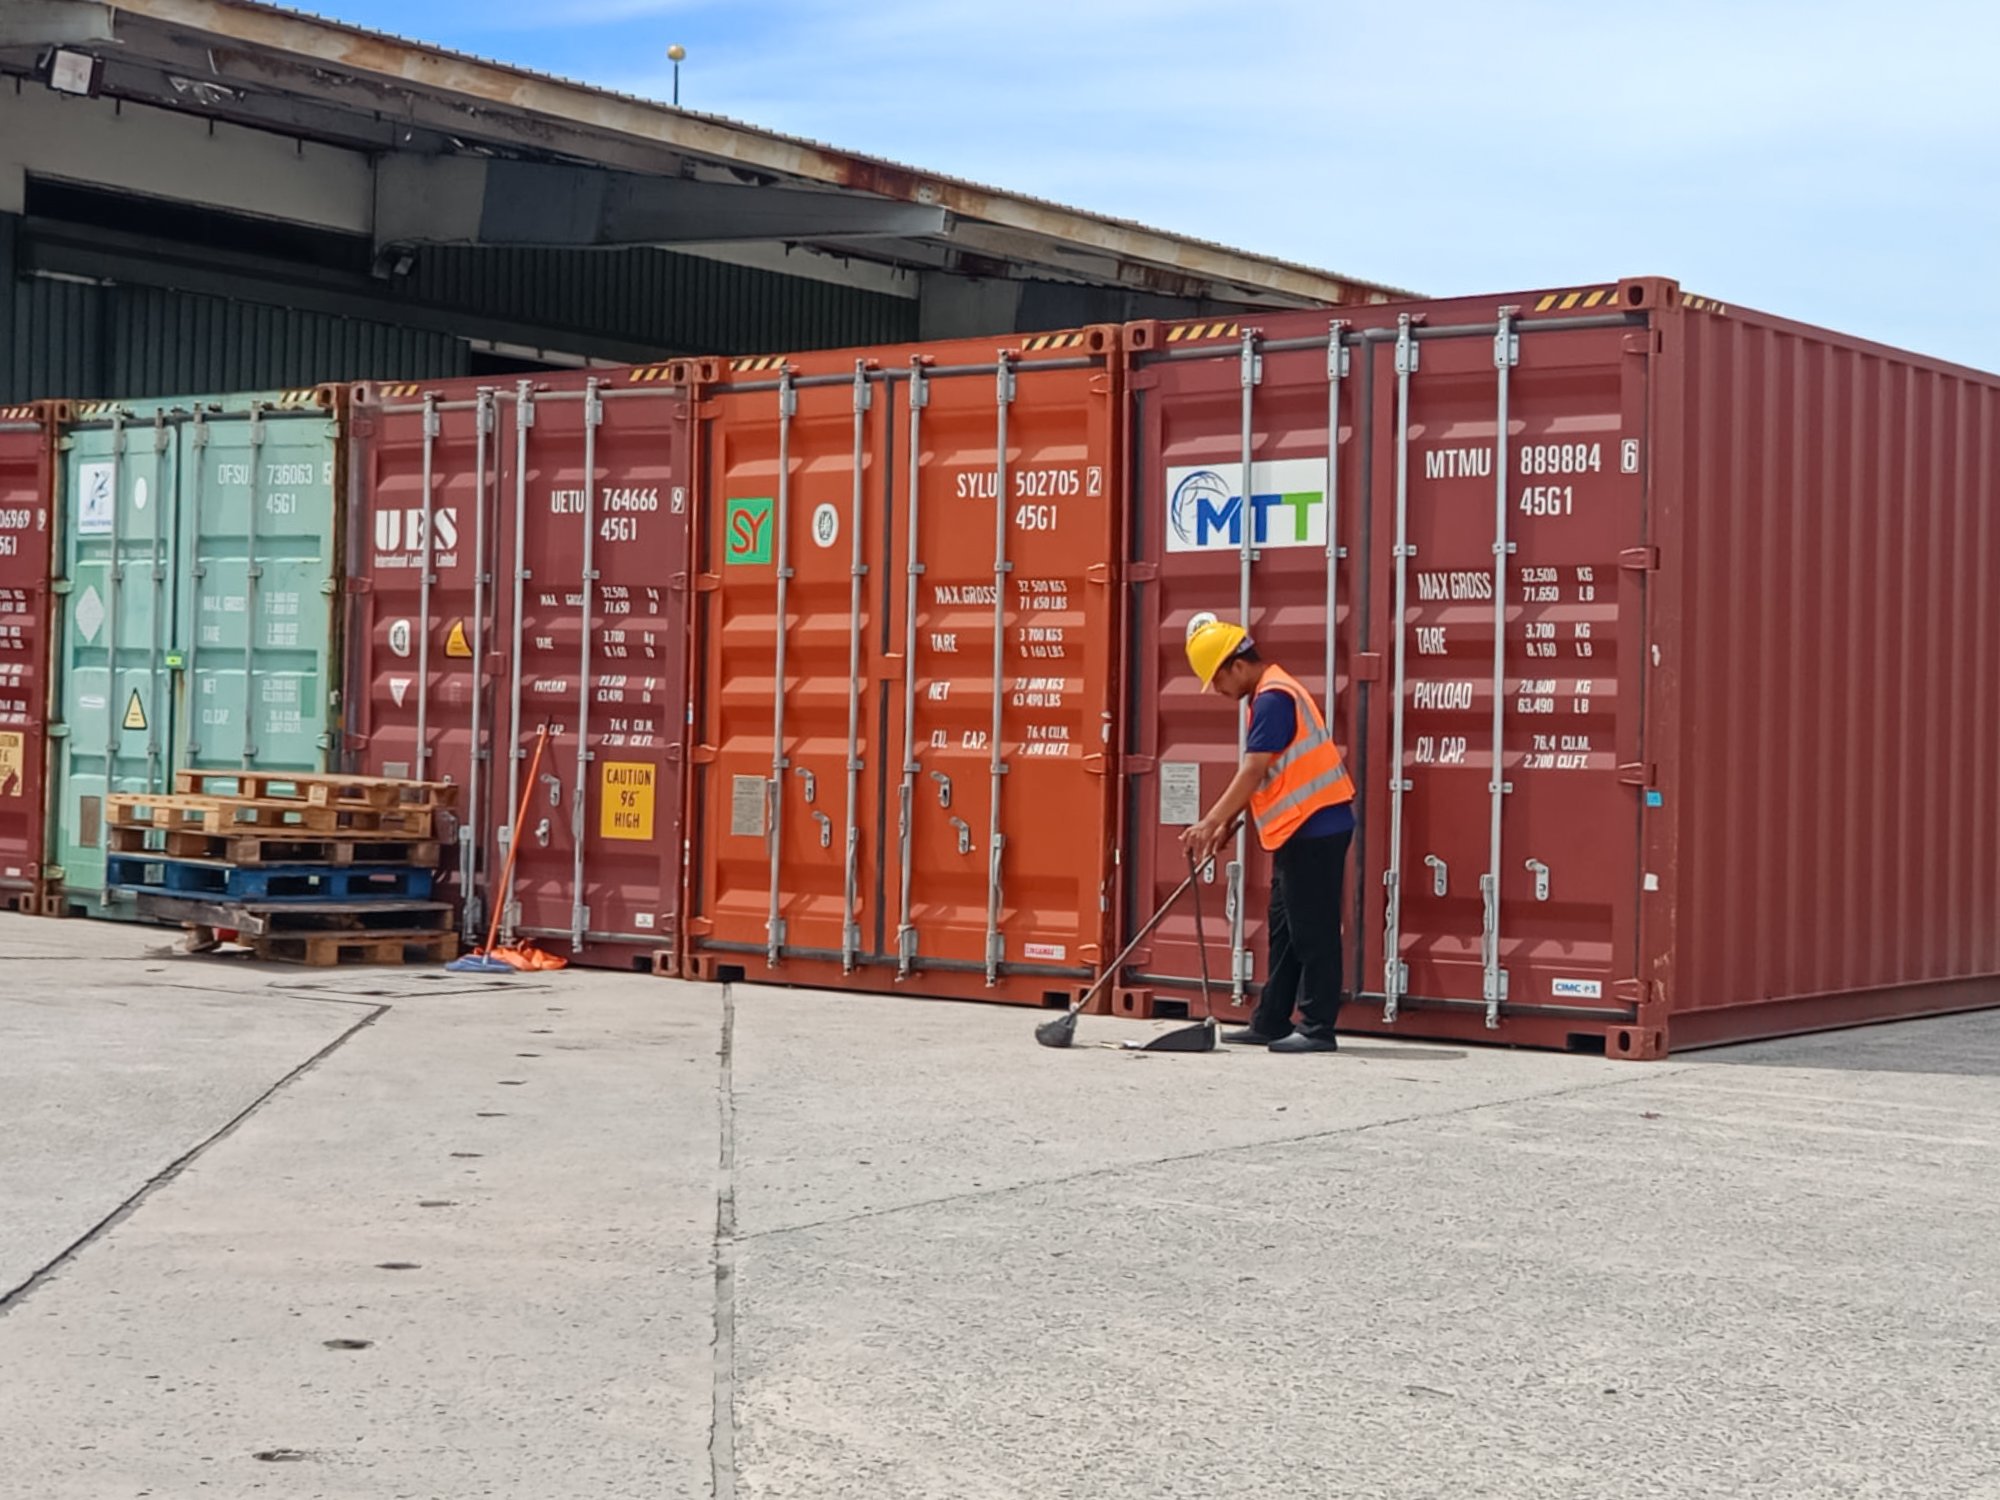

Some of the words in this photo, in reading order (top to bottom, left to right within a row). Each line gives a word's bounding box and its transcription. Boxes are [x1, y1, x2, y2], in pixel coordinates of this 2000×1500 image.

[1425, 447, 1492, 479] MTMU
[1520, 443, 1601, 475] 889884
[1622, 440, 1638, 473] 6
[956, 472, 998, 499] SYLU
[1015, 470, 1080, 497] 502705
[1088, 468, 1101, 496] 2
[551, 490, 585, 514] UETU
[602, 488, 658, 512] 764666
[672, 488, 684, 513] 9
[1520, 486, 1573, 516] 45G1
[1015, 505, 1058, 531] 45G1
[1196, 491, 1324, 546] MTT
[600, 517, 637, 541] 45G1
[731, 508, 768, 554] SY
[1521, 568, 1558, 583] 32.500
[1577, 567, 1594, 582] KG
[1418, 572, 1450, 600] MAX
[1450, 572, 1492, 600] GROSS
[1578, 586, 1595, 601] LB
[1415, 627, 1448, 656] TARE
[1525, 624, 1556, 639] 3.700
[1575, 623, 1591, 638] KG
[931, 633, 959, 652] TARE
[1576, 642, 1593, 657] LB
[928, 682, 951, 701] NET
[1413, 682, 1473, 710] PAYLOAD
[1575, 679, 1592, 695] KG
[1574, 699, 1590, 714] LB
[962, 731, 988, 750] CAP.
[1416, 737, 1436, 763] CU.
[1439, 737, 1467, 764] CAP.
[1532, 735, 1557, 751] 76.4
[606, 769, 652, 786] CAUTION
[614, 813, 641, 829] HIGH
